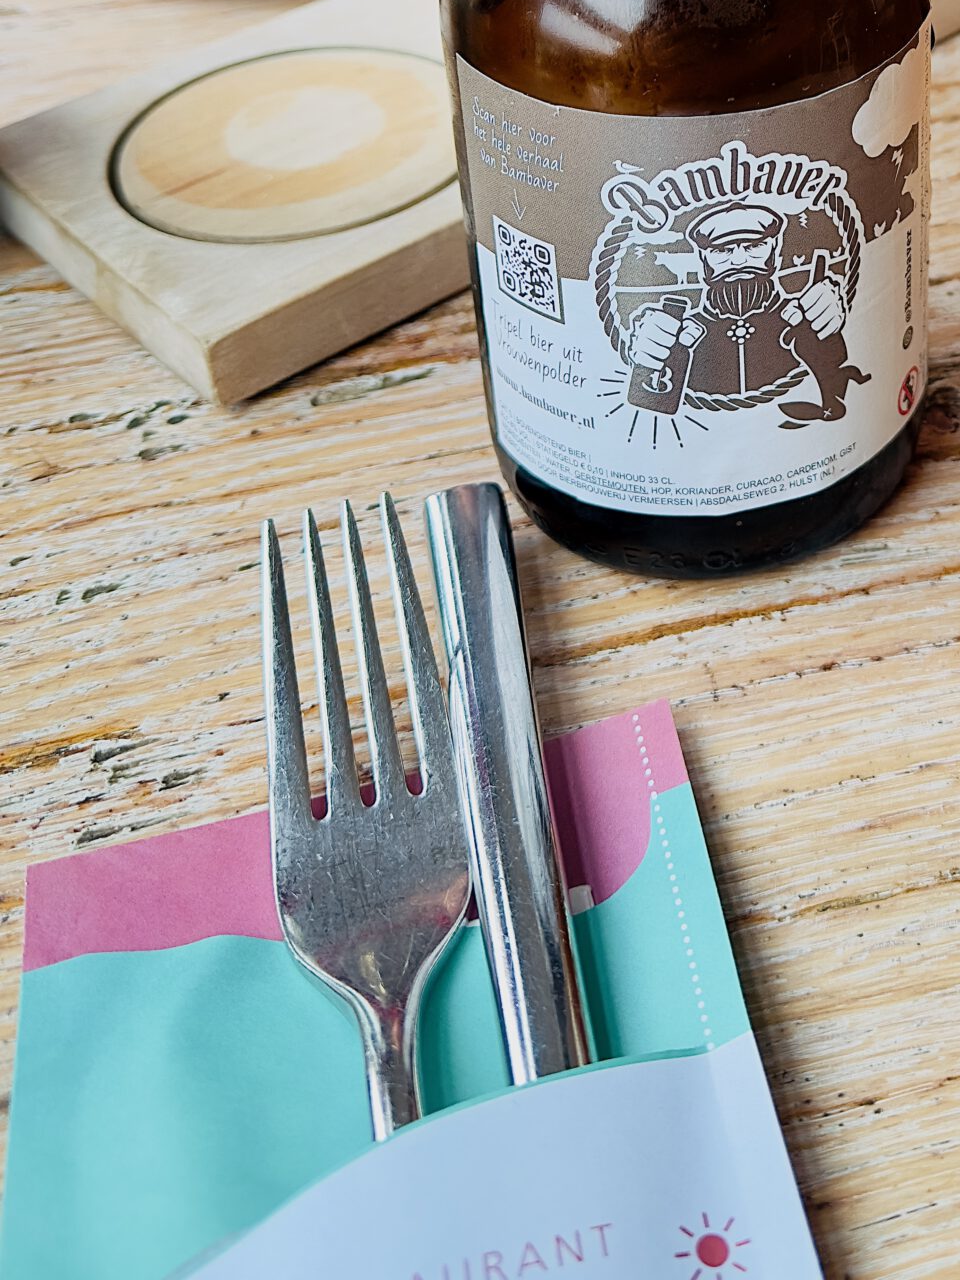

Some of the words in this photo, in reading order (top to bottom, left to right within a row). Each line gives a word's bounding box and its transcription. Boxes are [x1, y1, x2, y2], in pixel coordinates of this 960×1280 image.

[472, 96, 496, 125] Scan
[501, 112, 522, 136] hier
[529, 127, 556, 147] voor
[473, 116, 486, 141] het
[491, 129, 511, 155] hele
[516, 145, 564, 173] verhaal
[480, 147, 496, 168] van
[491, 297, 522, 339] Tripel
[530, 324, 554, 353] bier
[562, 346, 583, 363] uit
[567, 447, 587, 460] BIER
[651, 486, 673, 496] HOP,
[675, 484, 734, 496] KORIANDER,
[839, 442, 857, 458] GIST
[559, 472, 626, 501] BIERBROUWERIJ
[628, 495, 693, 506] VERMEERSEN
[700, 485, 777, 506] ABSDAALSEWEG
[789, 473, 818, 488] HULST
[610, 470, 646, 483] INHOUD
[648, 476, 659, 484] 33
